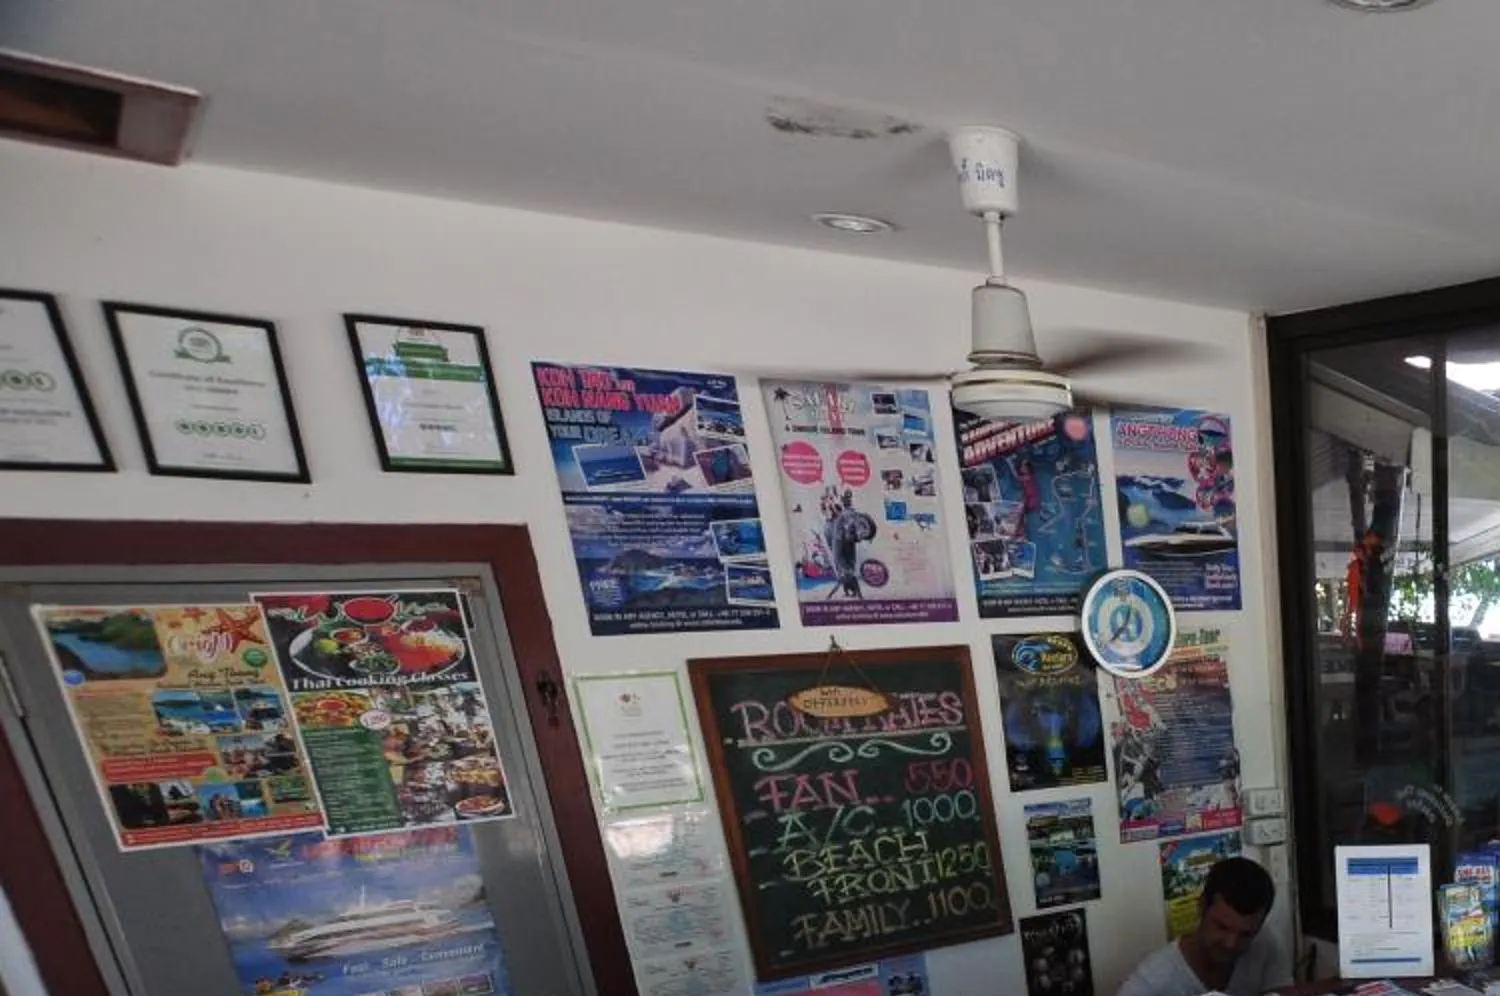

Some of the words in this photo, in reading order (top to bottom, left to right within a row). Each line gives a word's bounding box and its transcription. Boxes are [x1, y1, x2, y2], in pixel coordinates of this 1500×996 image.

[292, 676, 333, 691] Thai
[336, 672, 407, 688] Cooking
[782, 830, 930, 884] BEACH
